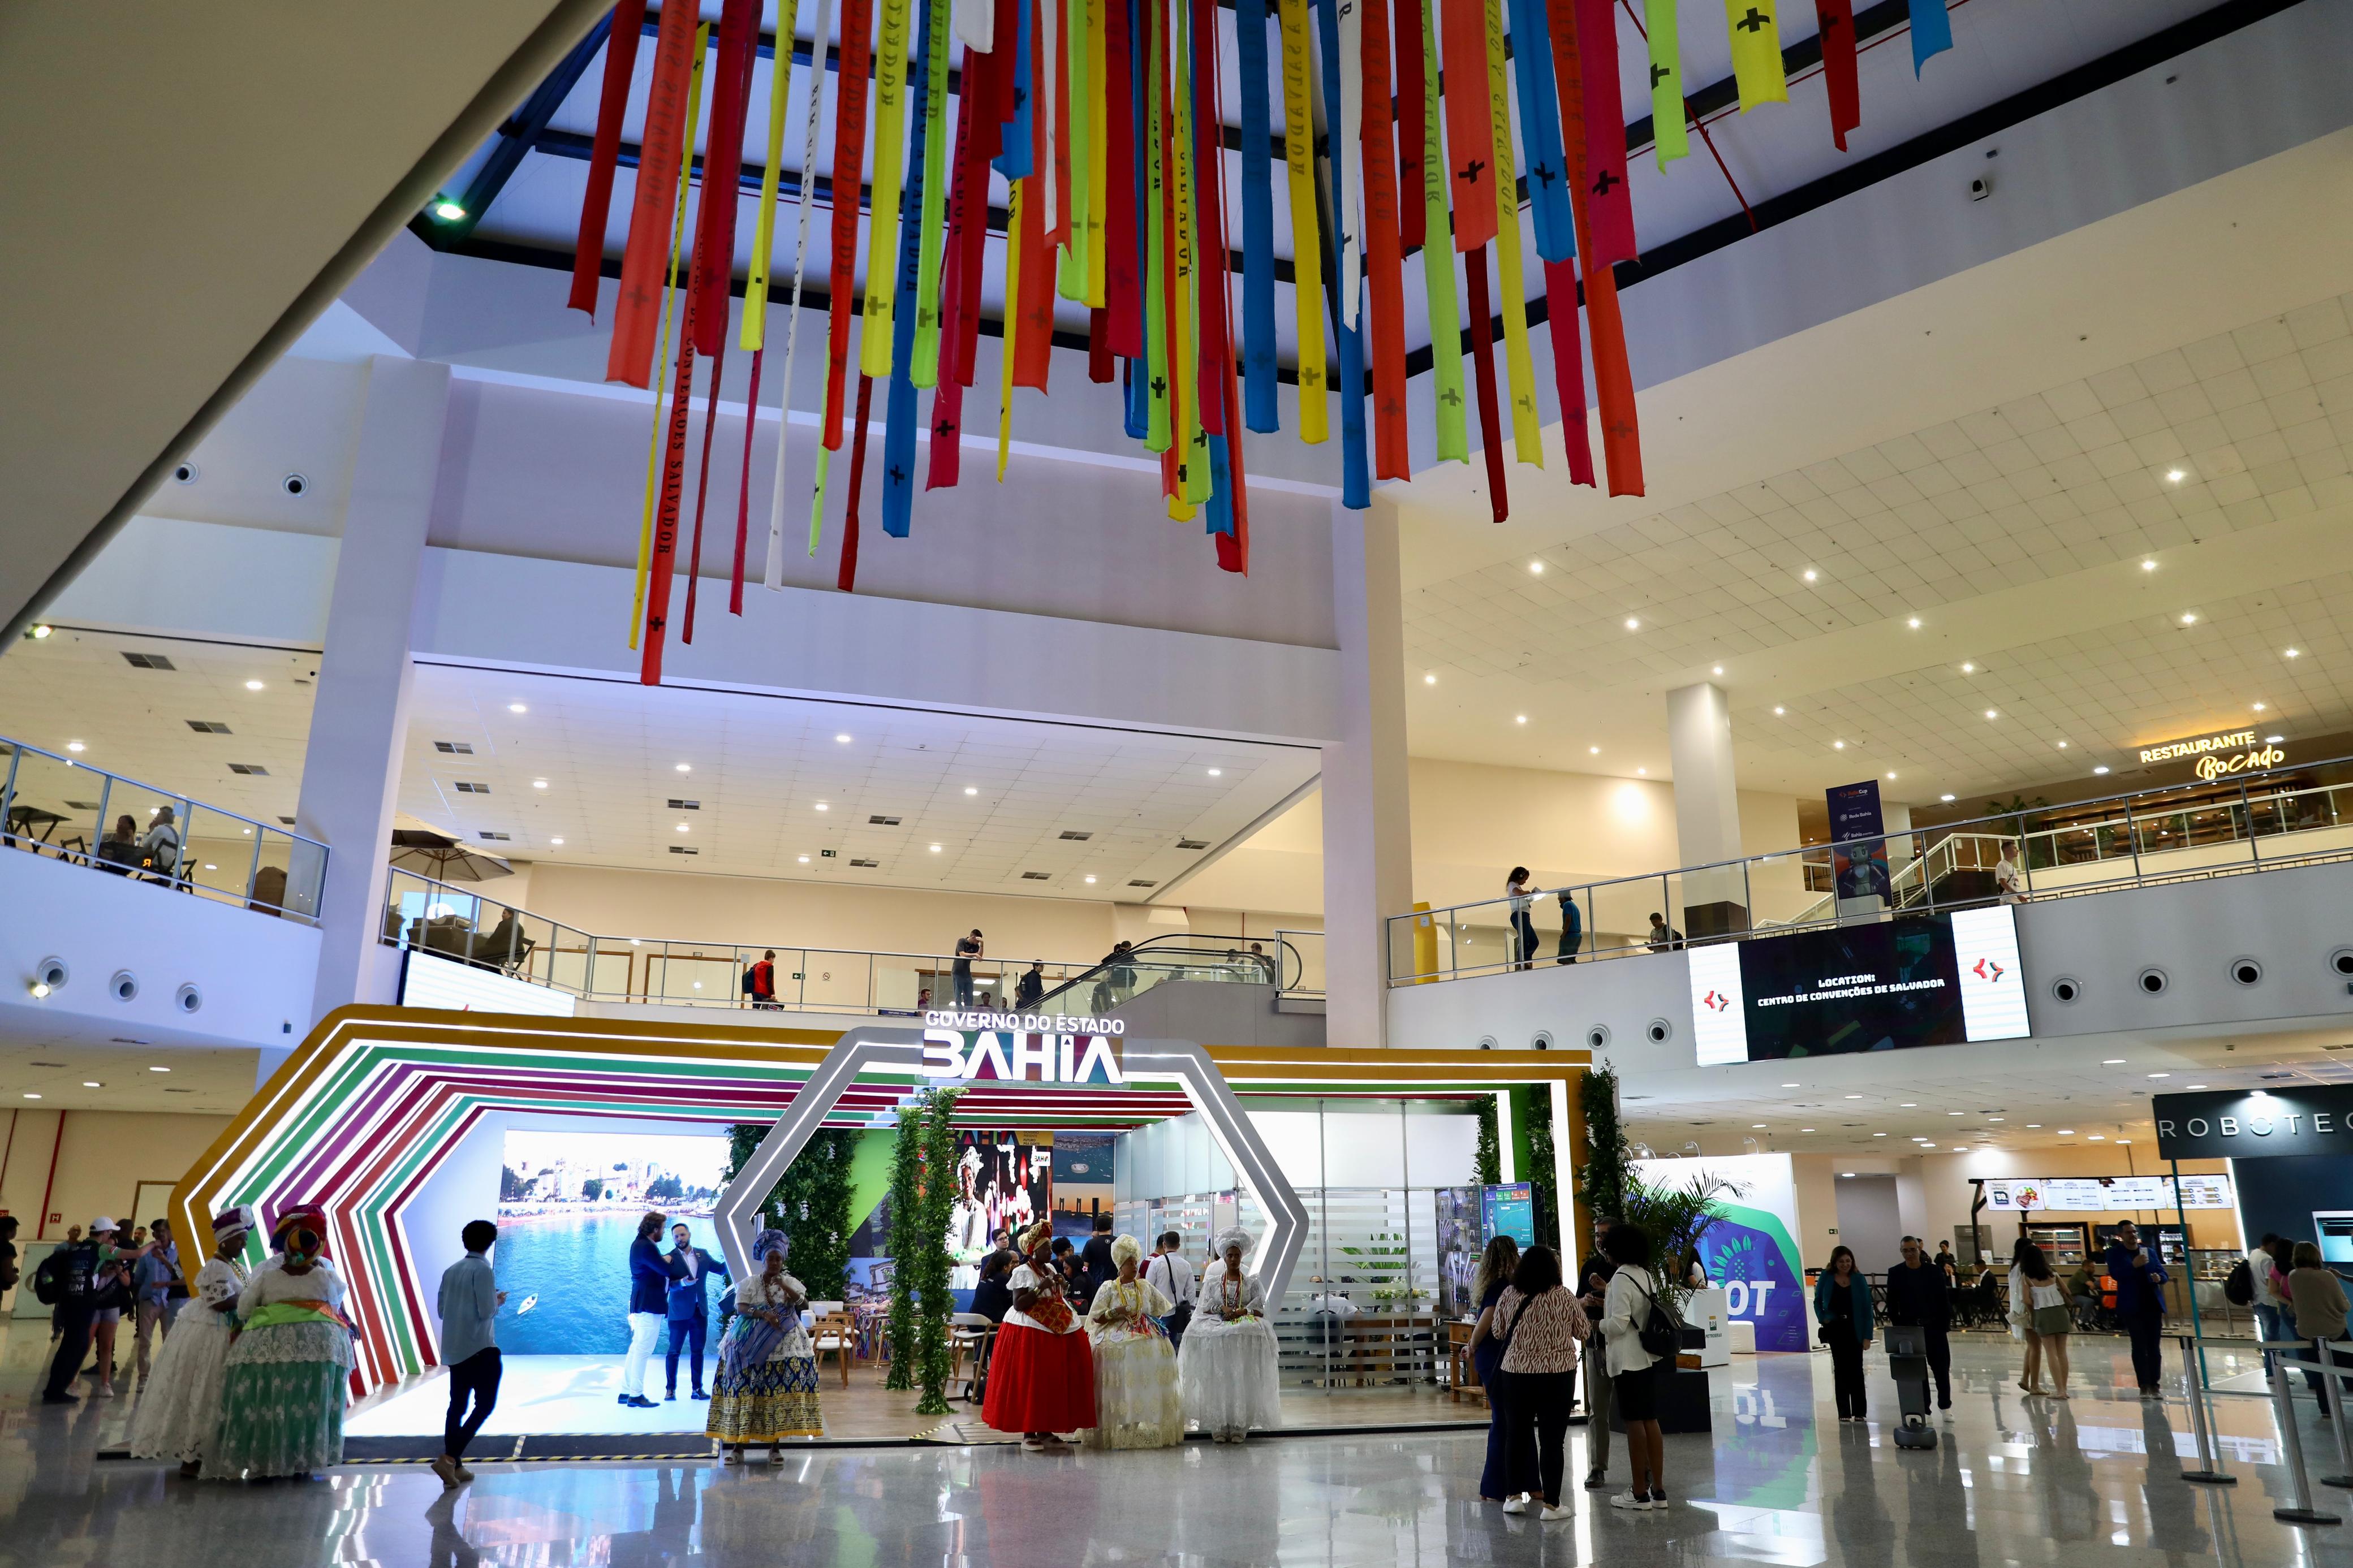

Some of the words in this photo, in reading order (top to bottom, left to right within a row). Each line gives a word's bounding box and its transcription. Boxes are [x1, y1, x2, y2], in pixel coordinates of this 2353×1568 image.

[658, 460, 682, 554] SALVADOR
[2140, 731, 2256, 763] RESTAURANTE
[1757, 995, 1794, 1007] CENTRO
[1795, 994, 1808, 1003] DE
[1809, 986, 1873, 1003] CONVENÇÕES
[1874, 984, 1888, 994] DE
[1889, 978, 1945, 993] SALVADOR
[1818, 974, 1876, 988] LOCATION:
[925, 1010, 1019, 1030] GOVERNO
[1024, 1015, 1051, 1031] DO
[1056, 1017, 1125, 1035] ESTADO
[922, 1029, 1123, 1084] BAHIA
